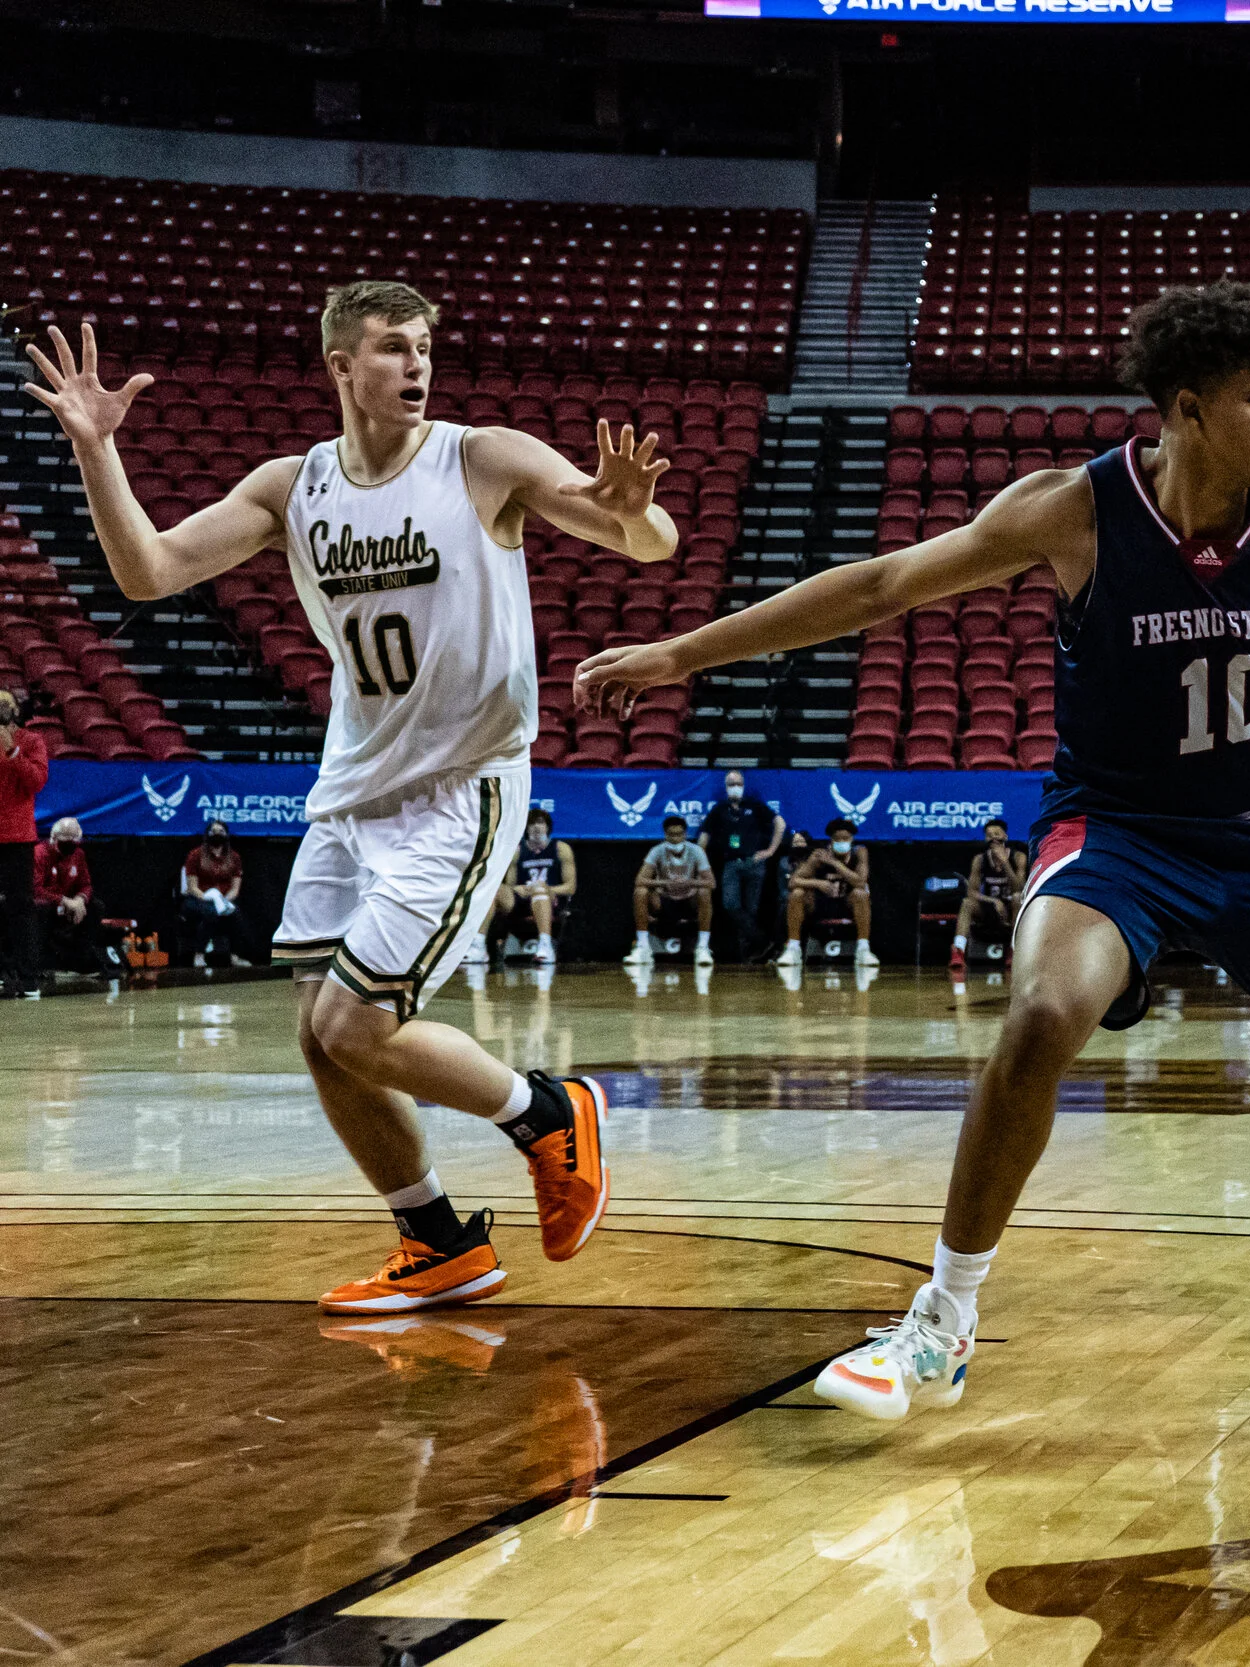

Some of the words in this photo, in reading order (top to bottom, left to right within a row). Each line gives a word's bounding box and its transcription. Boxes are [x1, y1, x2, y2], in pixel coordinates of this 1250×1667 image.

[308, 515, 431, 577] Colorado
[1193, 558, 1223, 566] adidas
[341, 575, 377, 594] STATE
[381, 570, 410, 591] UNIV
[1131, 606, 1226, 647] FRESNO
[343, 612, 418, 697] 10
[196, 795, 239, 808] AIR
[243, 795, 306, 809] FORC
[887, 801, 927, 815] AIR
[931, 801, 1004, 816] FORCE
